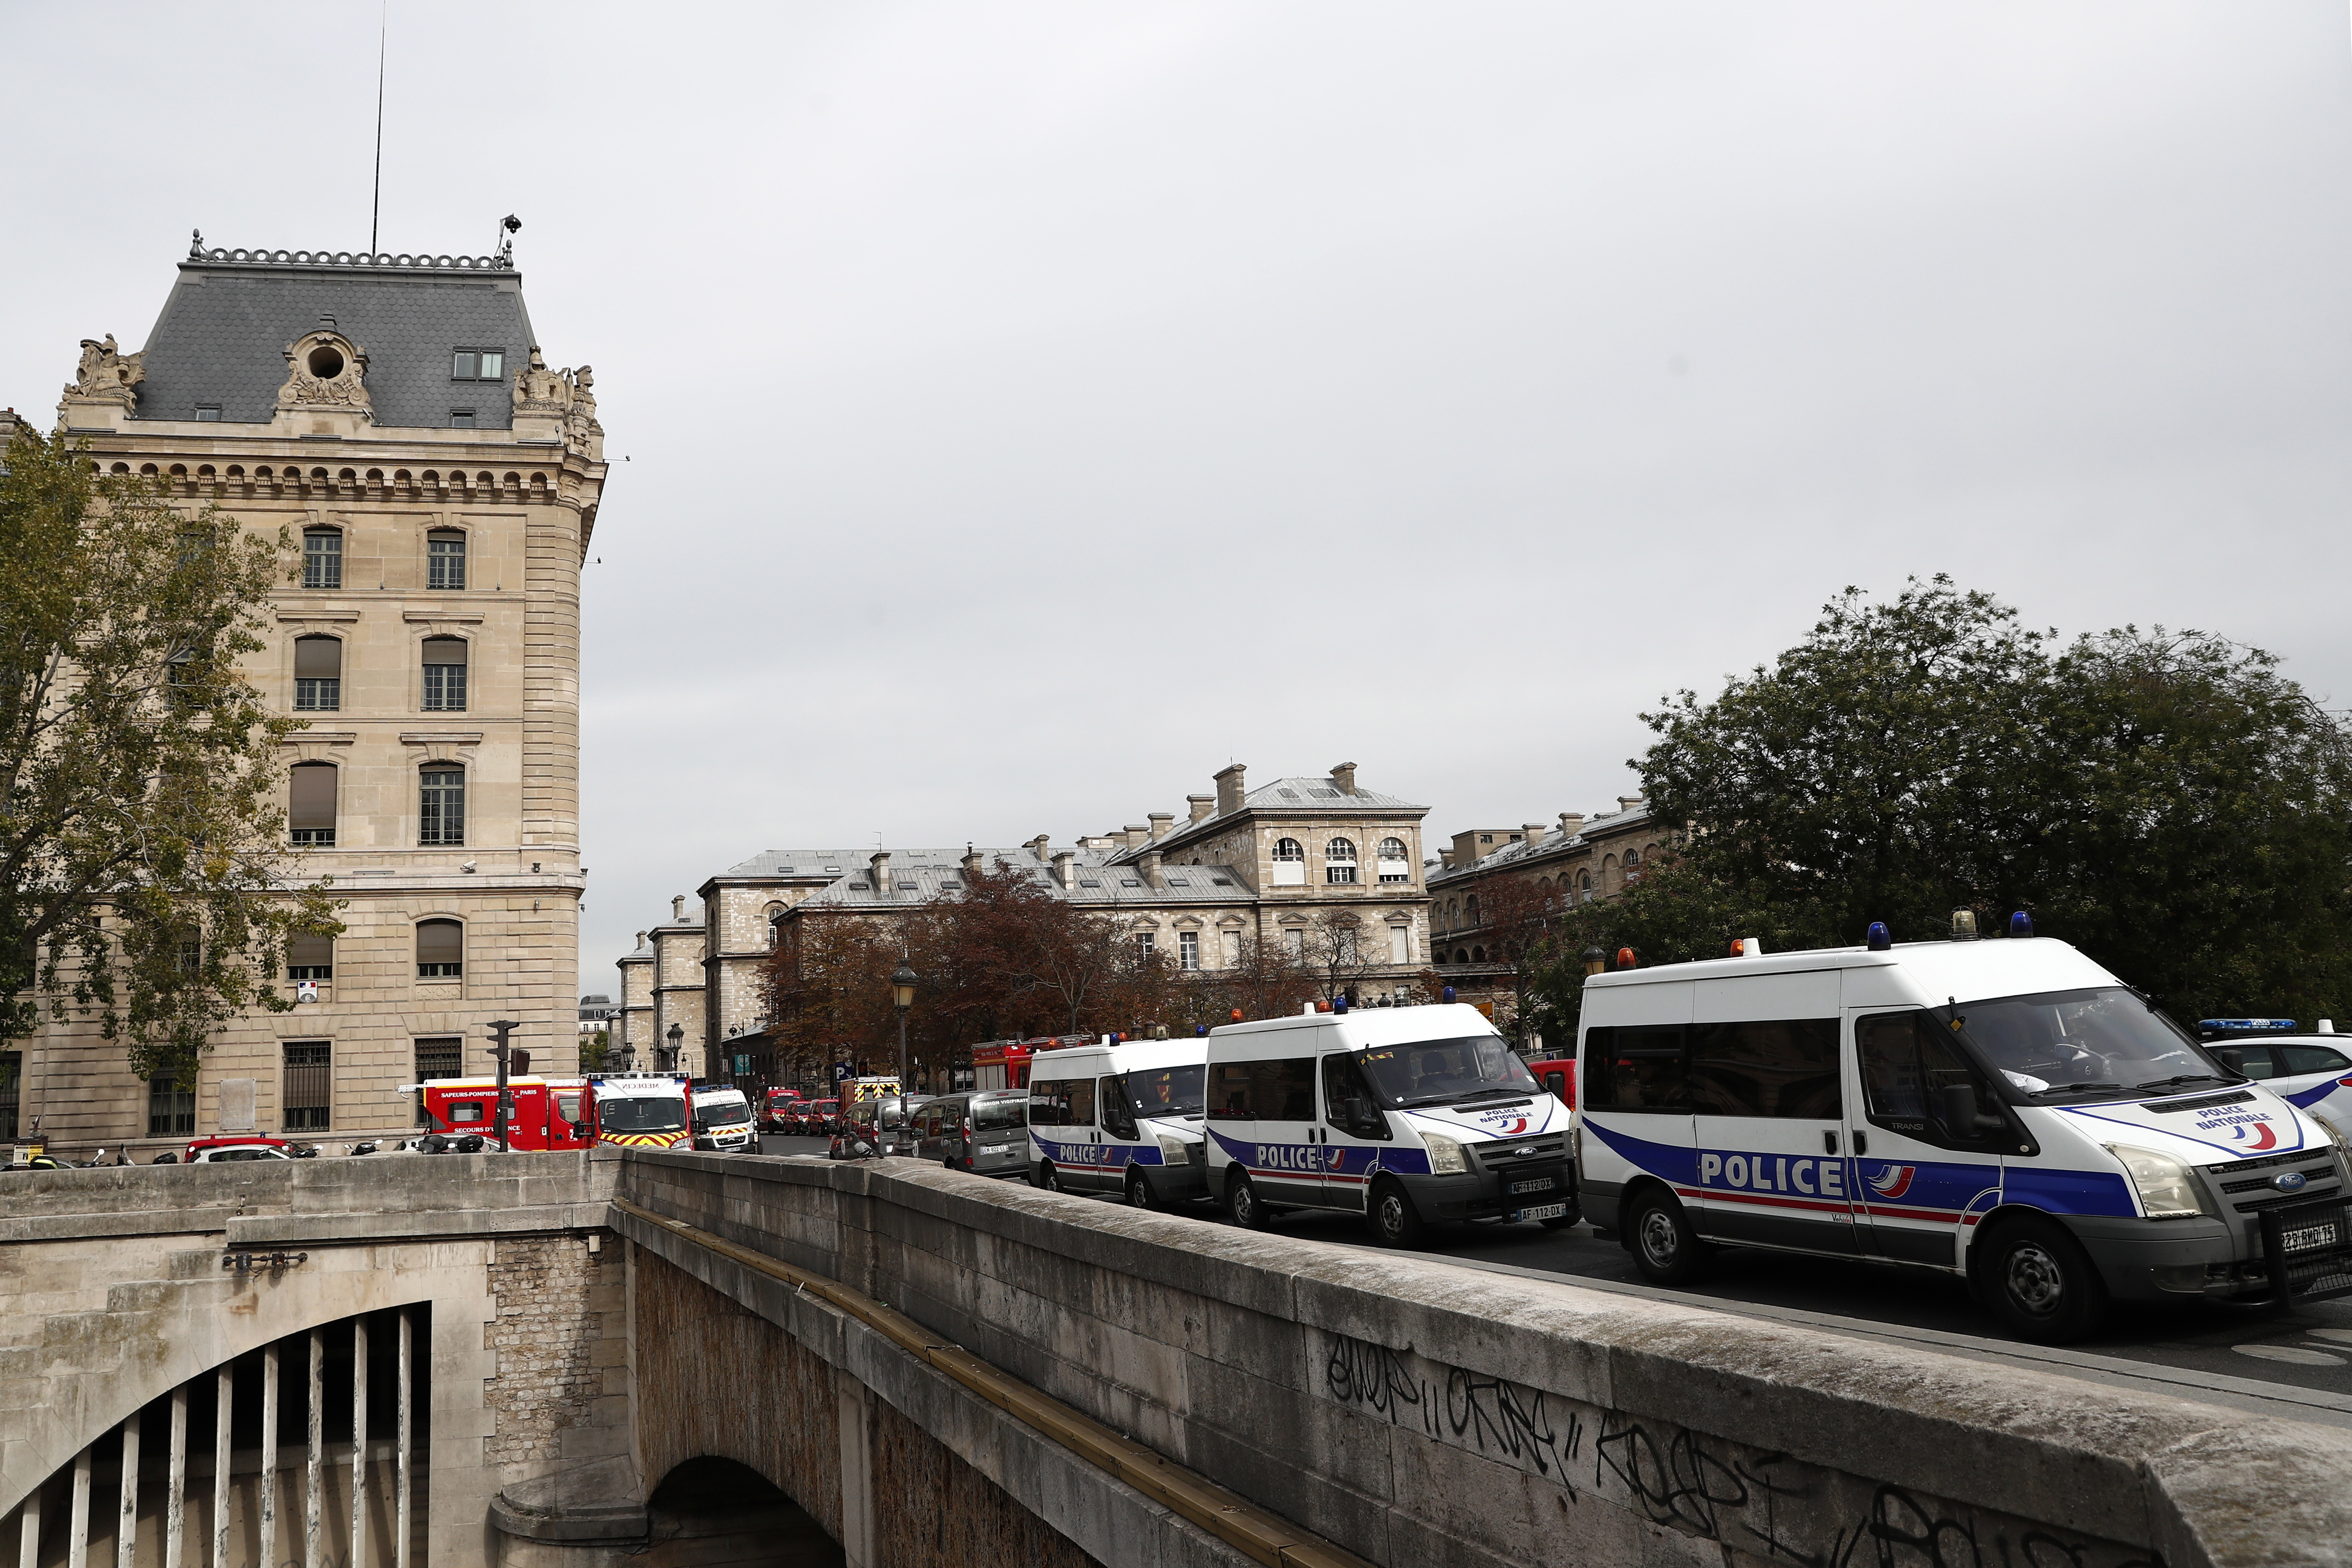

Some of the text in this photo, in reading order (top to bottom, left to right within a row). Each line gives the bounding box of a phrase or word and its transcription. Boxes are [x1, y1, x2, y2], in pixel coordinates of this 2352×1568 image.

[836, 1067, 845, 1079] P
[1479, 1112, 1534, 1123] NATIONALE
[2196, 1106, 2248, 1118] POLICE
[2195, 1113, 2274, 1130] NATIONALE
[1060, 1145, 1096, 1163] POLICE
[1258, 1145, 1317, 1169] POLICE
[1701, 1153, 1844, 1196] POLICE
[2285, 1176, 2301, 1185] Ford
[2322, 1225, 2333, 1241] 75
